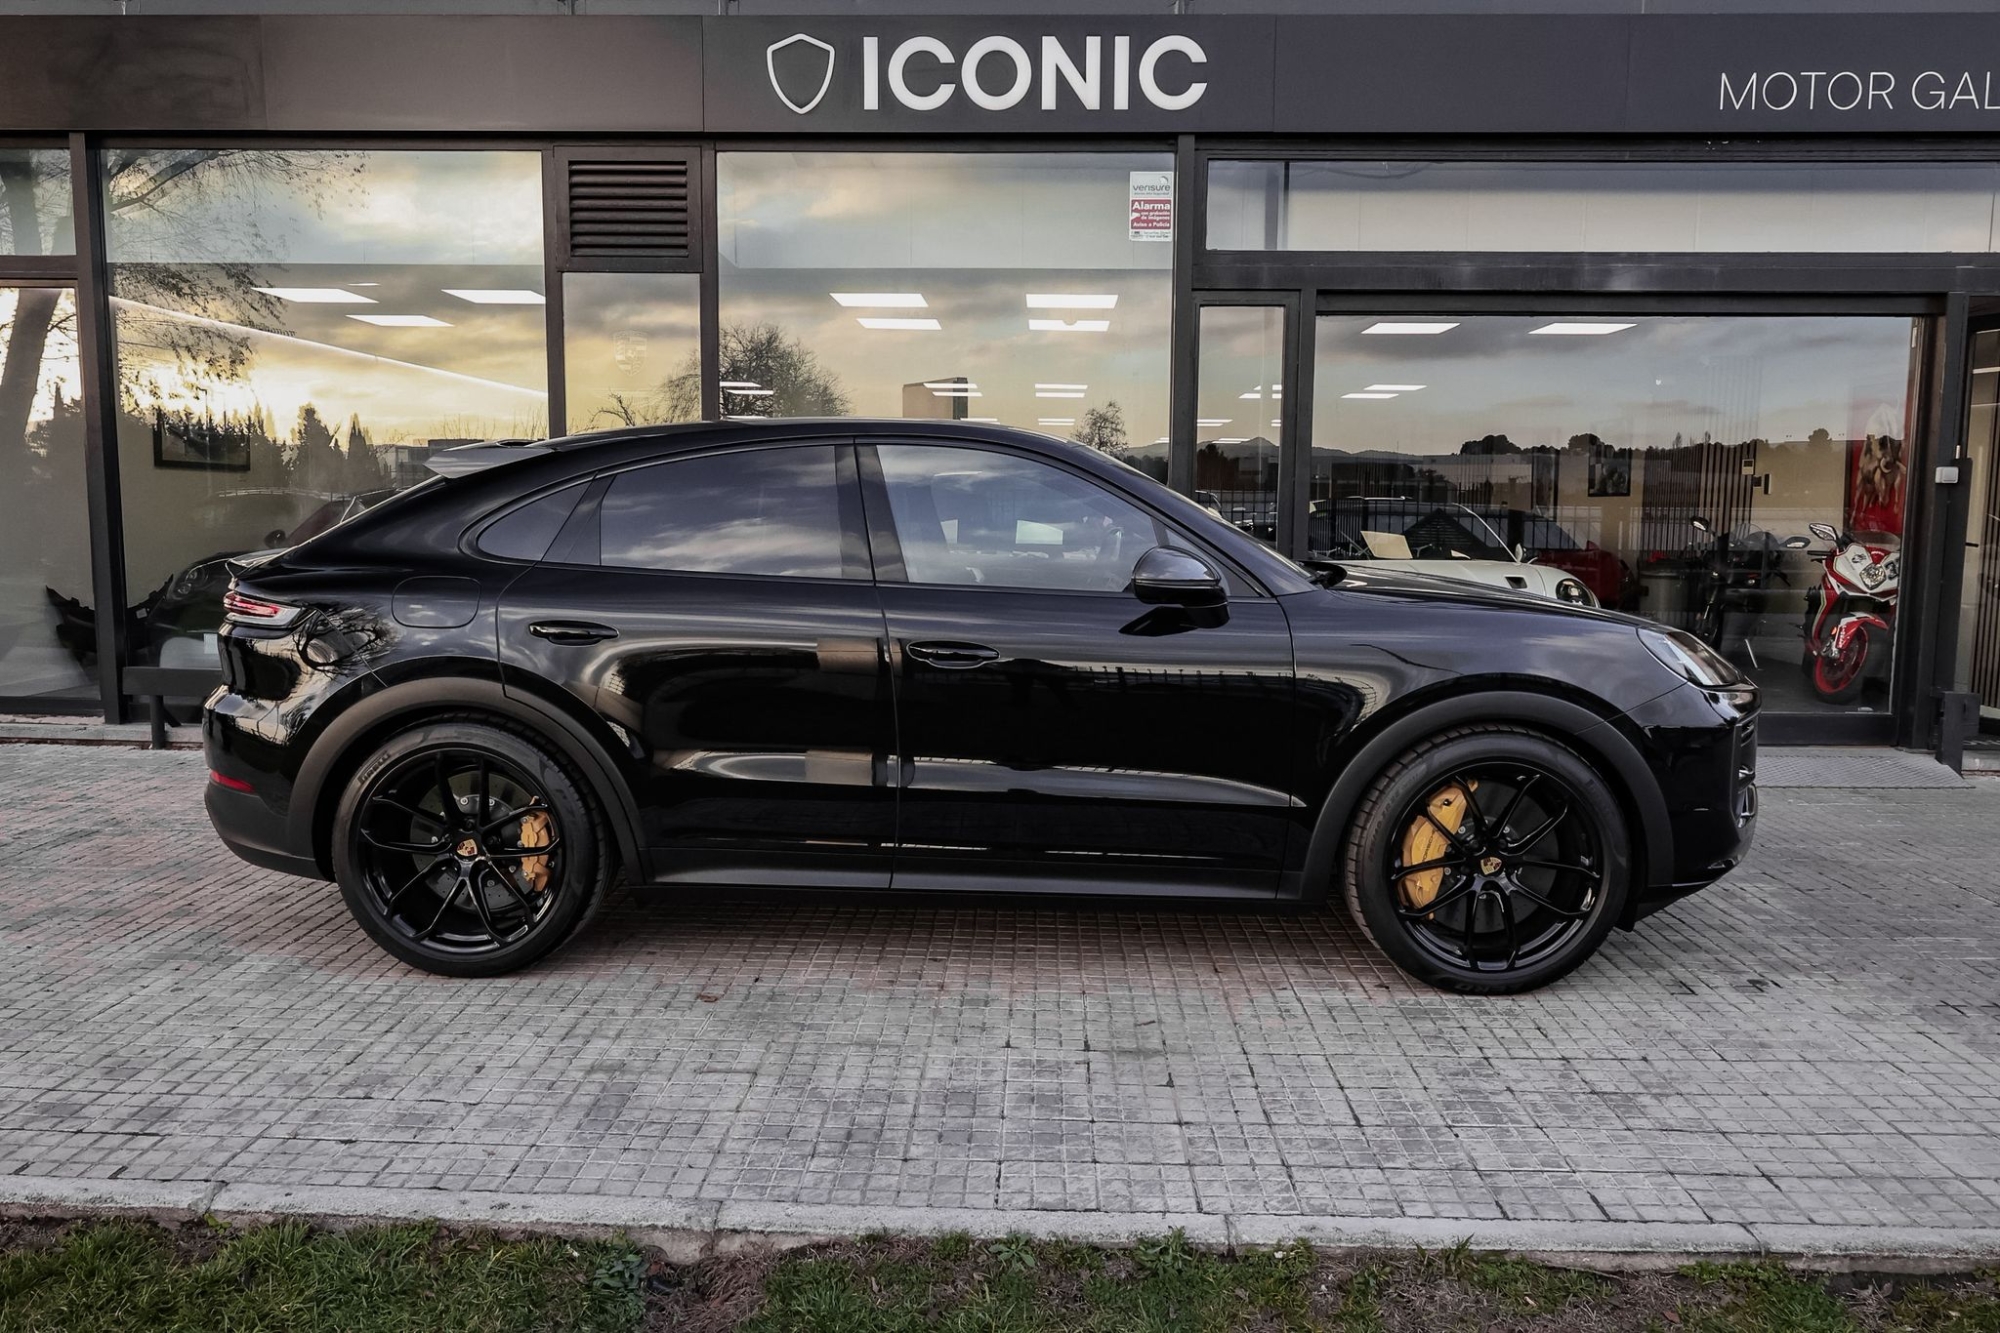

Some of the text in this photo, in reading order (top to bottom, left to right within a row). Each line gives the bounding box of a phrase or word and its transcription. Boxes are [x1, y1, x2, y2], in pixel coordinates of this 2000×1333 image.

[863, 35, 1208, 111] ICONIC
[1719, 71, 2000, 111] MOTOR GAL
[1132, 201, 1170, 210] Alarma
